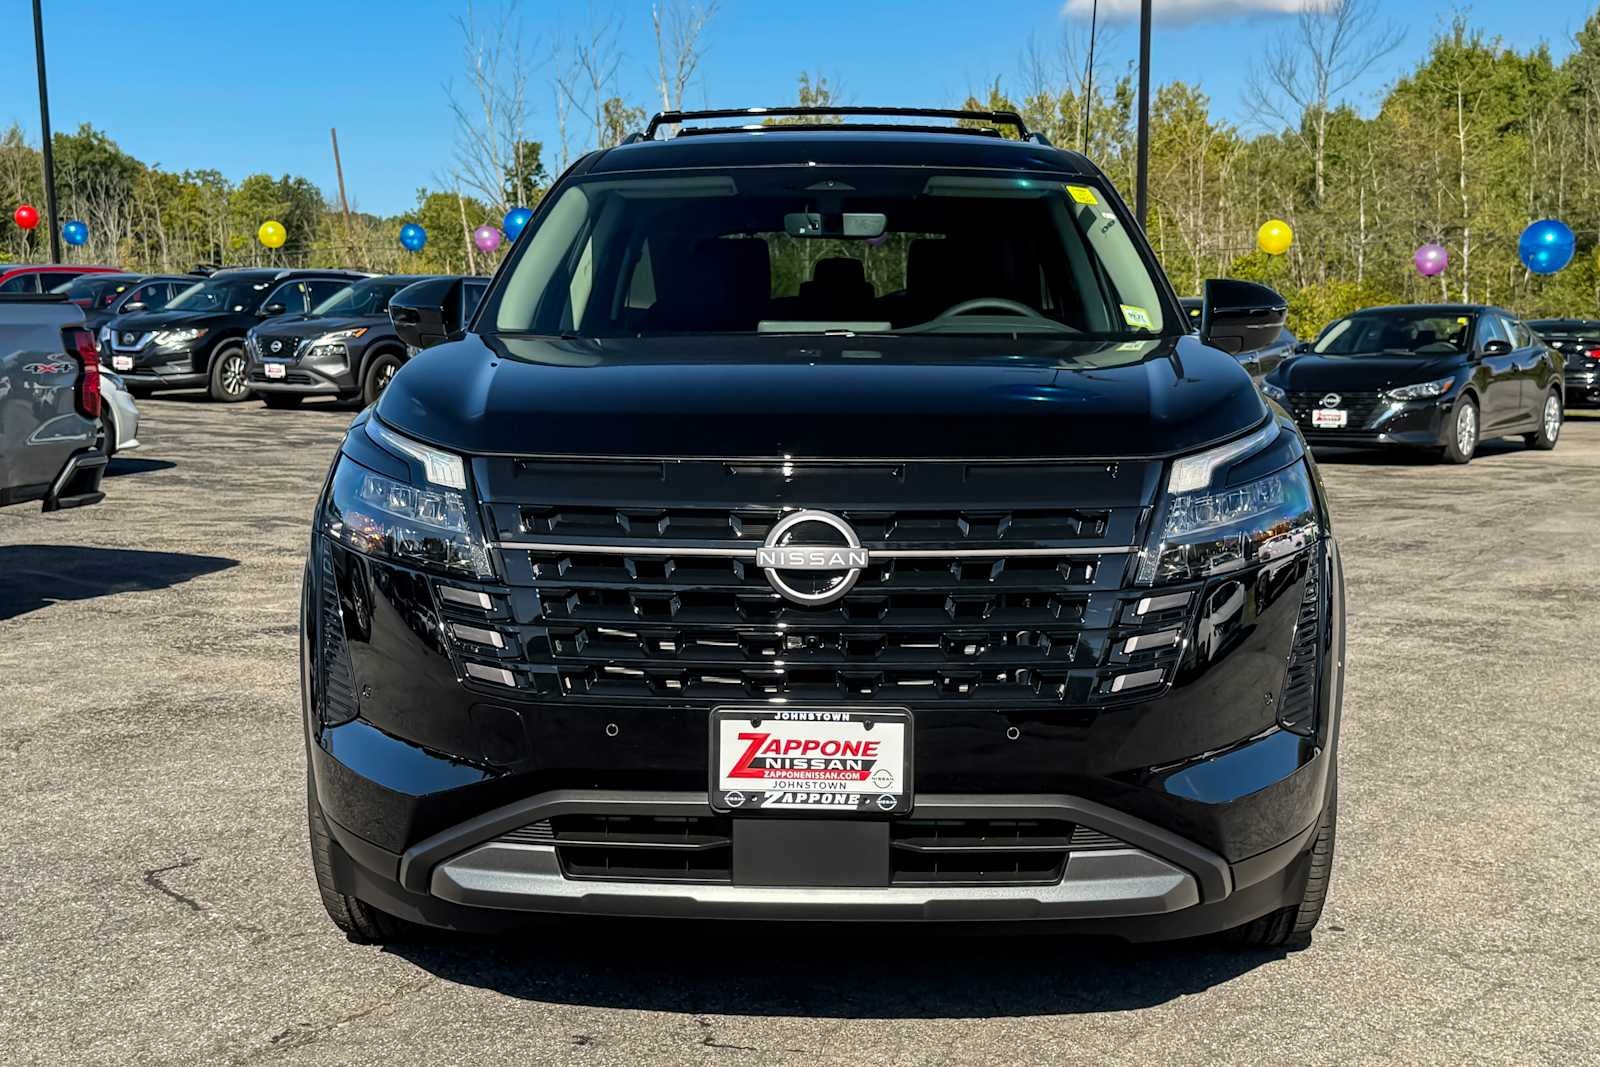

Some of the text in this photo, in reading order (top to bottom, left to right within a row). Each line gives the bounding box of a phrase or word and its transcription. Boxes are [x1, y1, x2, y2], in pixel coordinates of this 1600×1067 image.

[760, 551, 865, 566] NISSAN
[774, 711, 850, 721] JOHNSTOWN
[727, 732, 881, 779] ZAPPONE
[765, 758, 863, 771] NISSAN
[763, 770, 860, 780] ZAPPONENISSAN.COM
[773, 780, 847, 790] JOHNSTOWN
[761, 791, 861, 810] ZAPPONE
